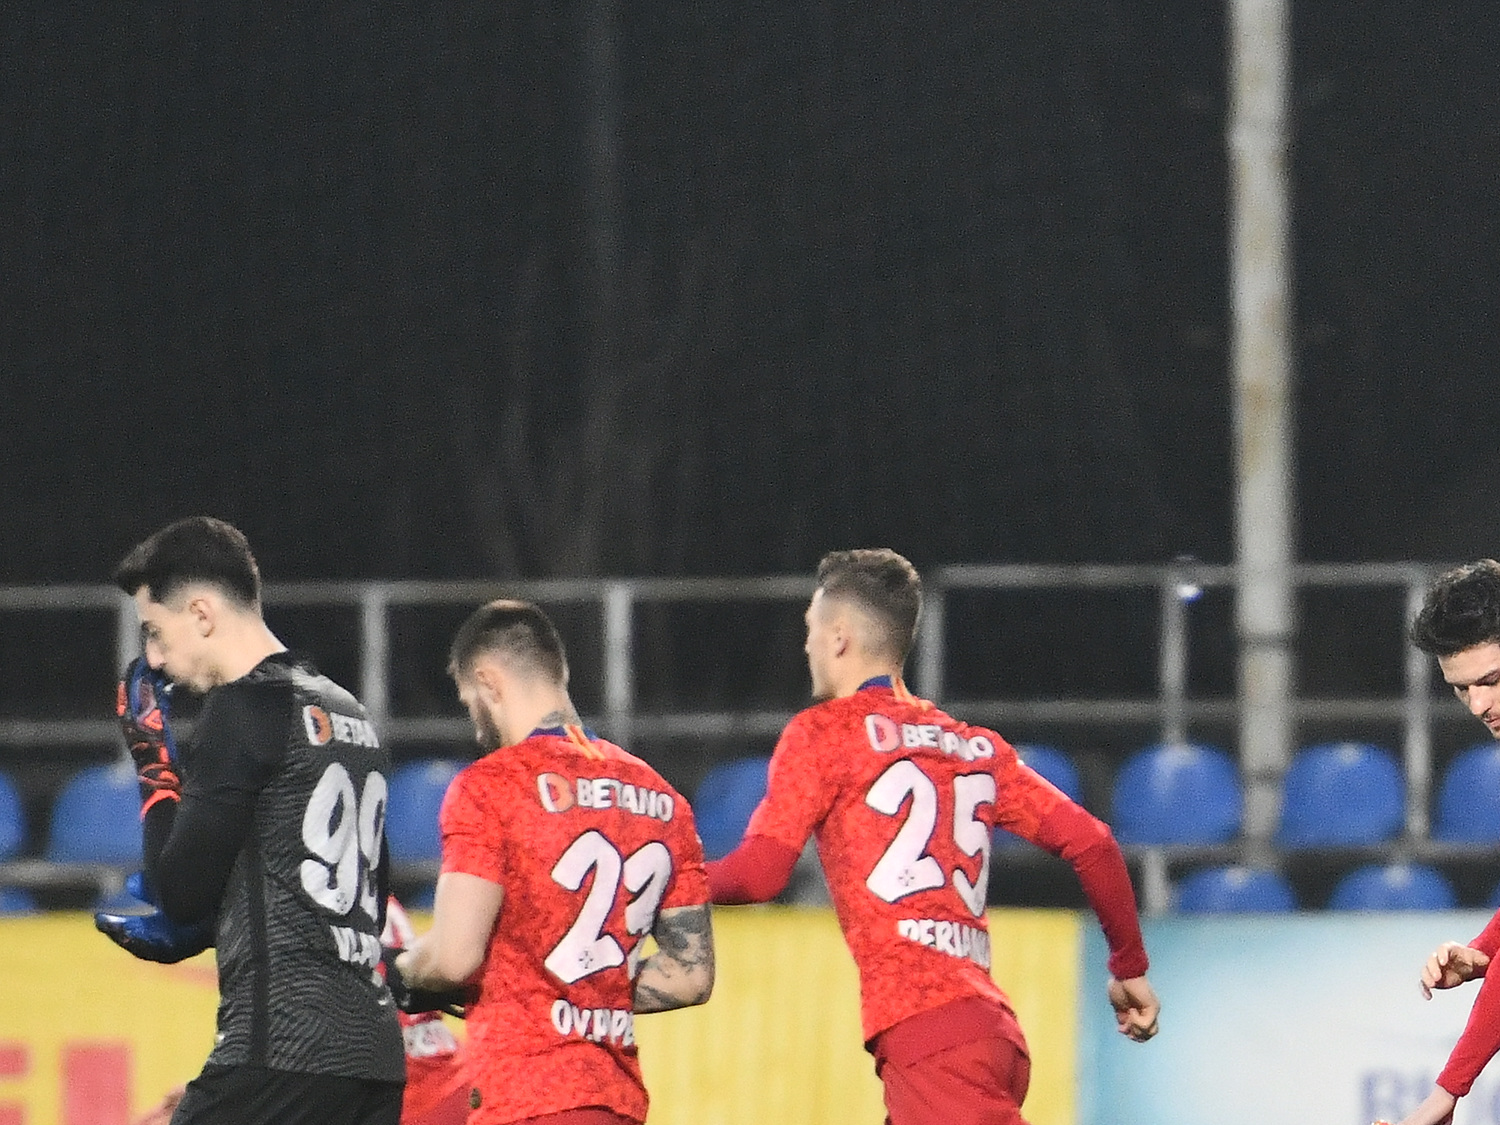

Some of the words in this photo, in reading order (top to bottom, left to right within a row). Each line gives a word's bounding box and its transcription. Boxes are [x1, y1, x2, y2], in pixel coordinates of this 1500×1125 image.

[902, 723, 995, 762] BEAO
[576, 777, 674, 822] BETANO
[865, 759, 996, 919] 25
